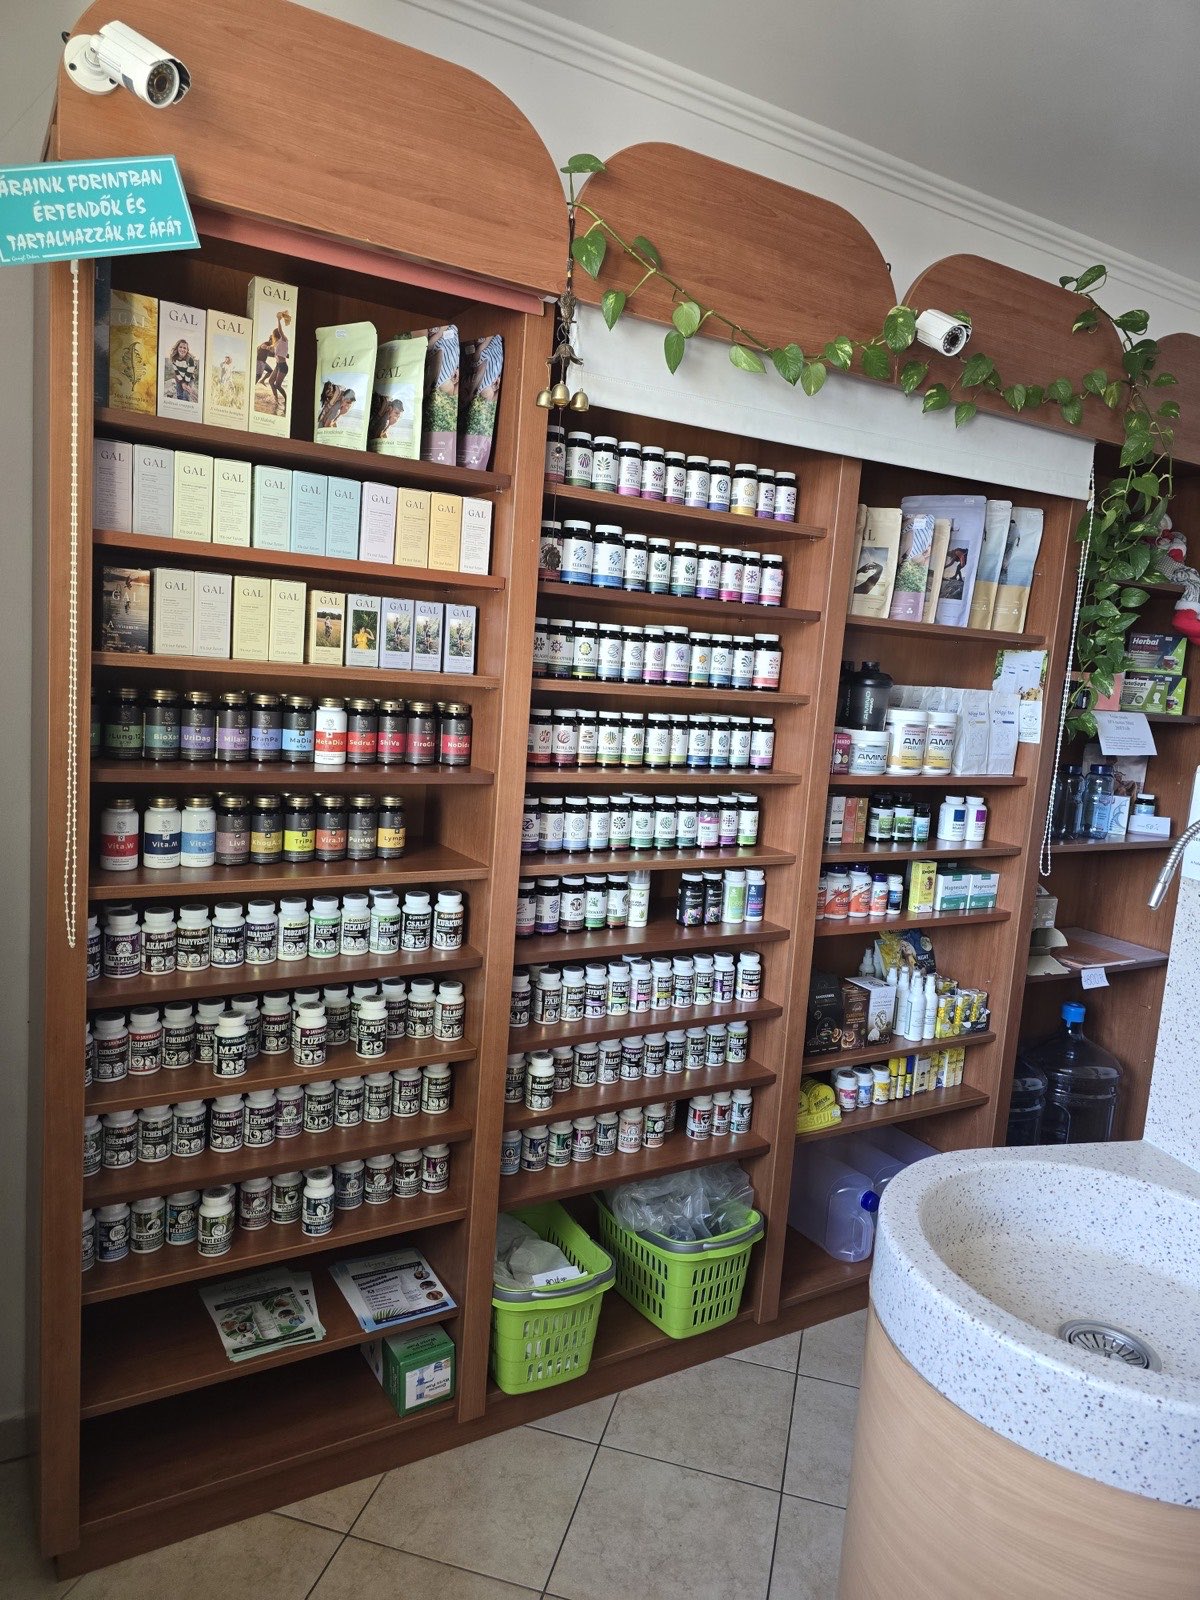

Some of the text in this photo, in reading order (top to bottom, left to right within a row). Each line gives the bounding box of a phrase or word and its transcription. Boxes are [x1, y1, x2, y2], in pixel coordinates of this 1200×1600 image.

[0, 169, 162, 197] ÁRAINK FORINTBAN
[33, 193, 146, 222] ÉRTENDŐK ÉS
[7, 216, 182, 251] TARTALMAZZÁK AZ ÁFÁT
[263, 285, 290, 301] GAL
[169, 309, 198, 326] GAL
[217, 318, 245, 335] GAL
[332, 355, 355, 368] GAL
[376, 367, 401, 379] GAL
[100, 451, 125, 462] GAL
[143, 458, 167, 469] GAL
[183, 466, 206, 477] GAL
[222, 472, 244, 483] GAL
[264, 479, 286, 490] GAL
[301, 484, 321, 495] GAL
[334, 489, 354, 500] GAL
[371, 494, 391, 505] GAL
[406, 500, 425, 510] GAL
[437, 504, 456, 514] GAL
[468, 509, 487, 519] GAL
[165, 582, 187, 592] GAL
[203, 585, 224, 595] GAL
[243, 589, 263, 598] GAL
[279, 592, 299, 601] GAL
[320, 597, 340, 606] GAL
[356, 599, 376, 608] GAL
[390, 602, 409, 611] GAL
[420, 606, 439, 614] GAL
[453, 609, 471, 617] GAL
[1132, 637, 1159, 646] Herbal
